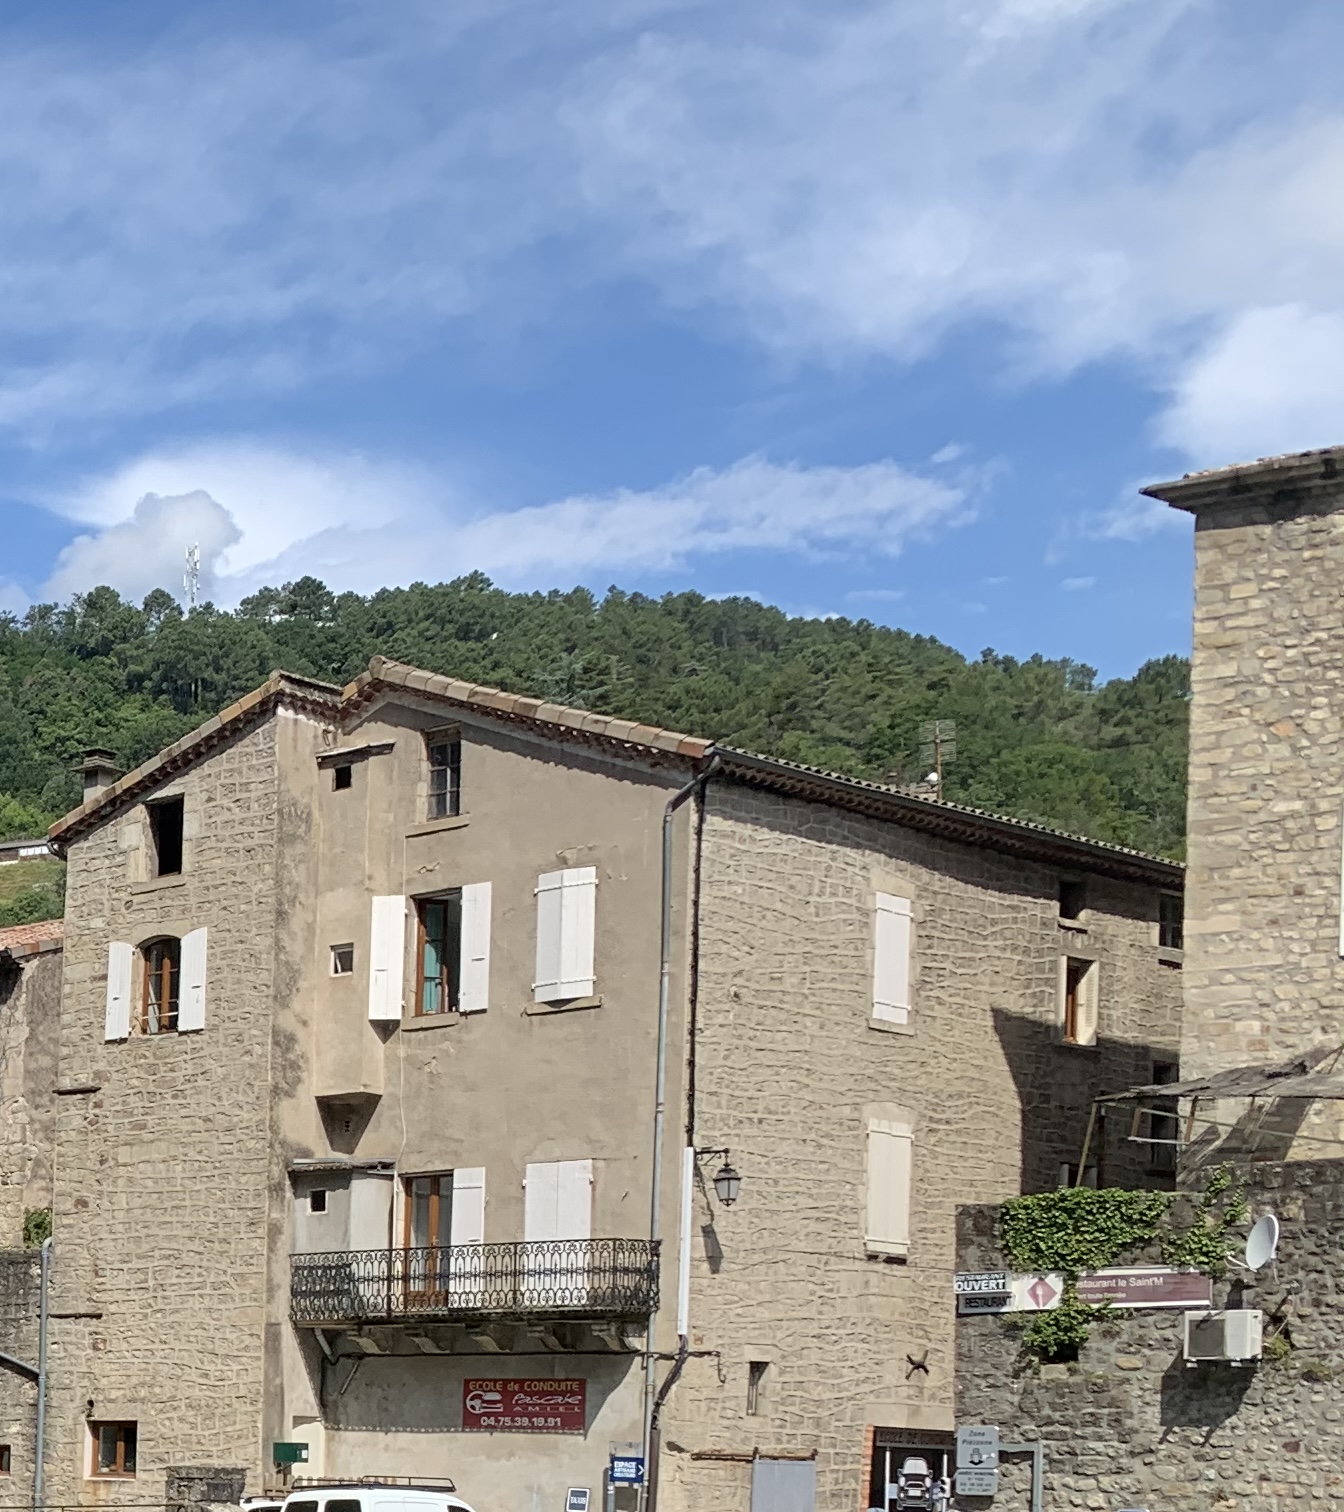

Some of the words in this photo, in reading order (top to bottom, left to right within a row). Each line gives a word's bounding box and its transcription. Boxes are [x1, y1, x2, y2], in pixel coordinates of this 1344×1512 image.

[955, 1280, 1005, 1291] OUVERT
[1118, 1278, 1127, 1287] le
[964, 1294, 1016, 1309] RESTAURANT
[469, 1381, 503, 1391] ECOLE
[507, 1381, 520, 1391] de
[524, 1381, 580, 1391] CONDUITE
